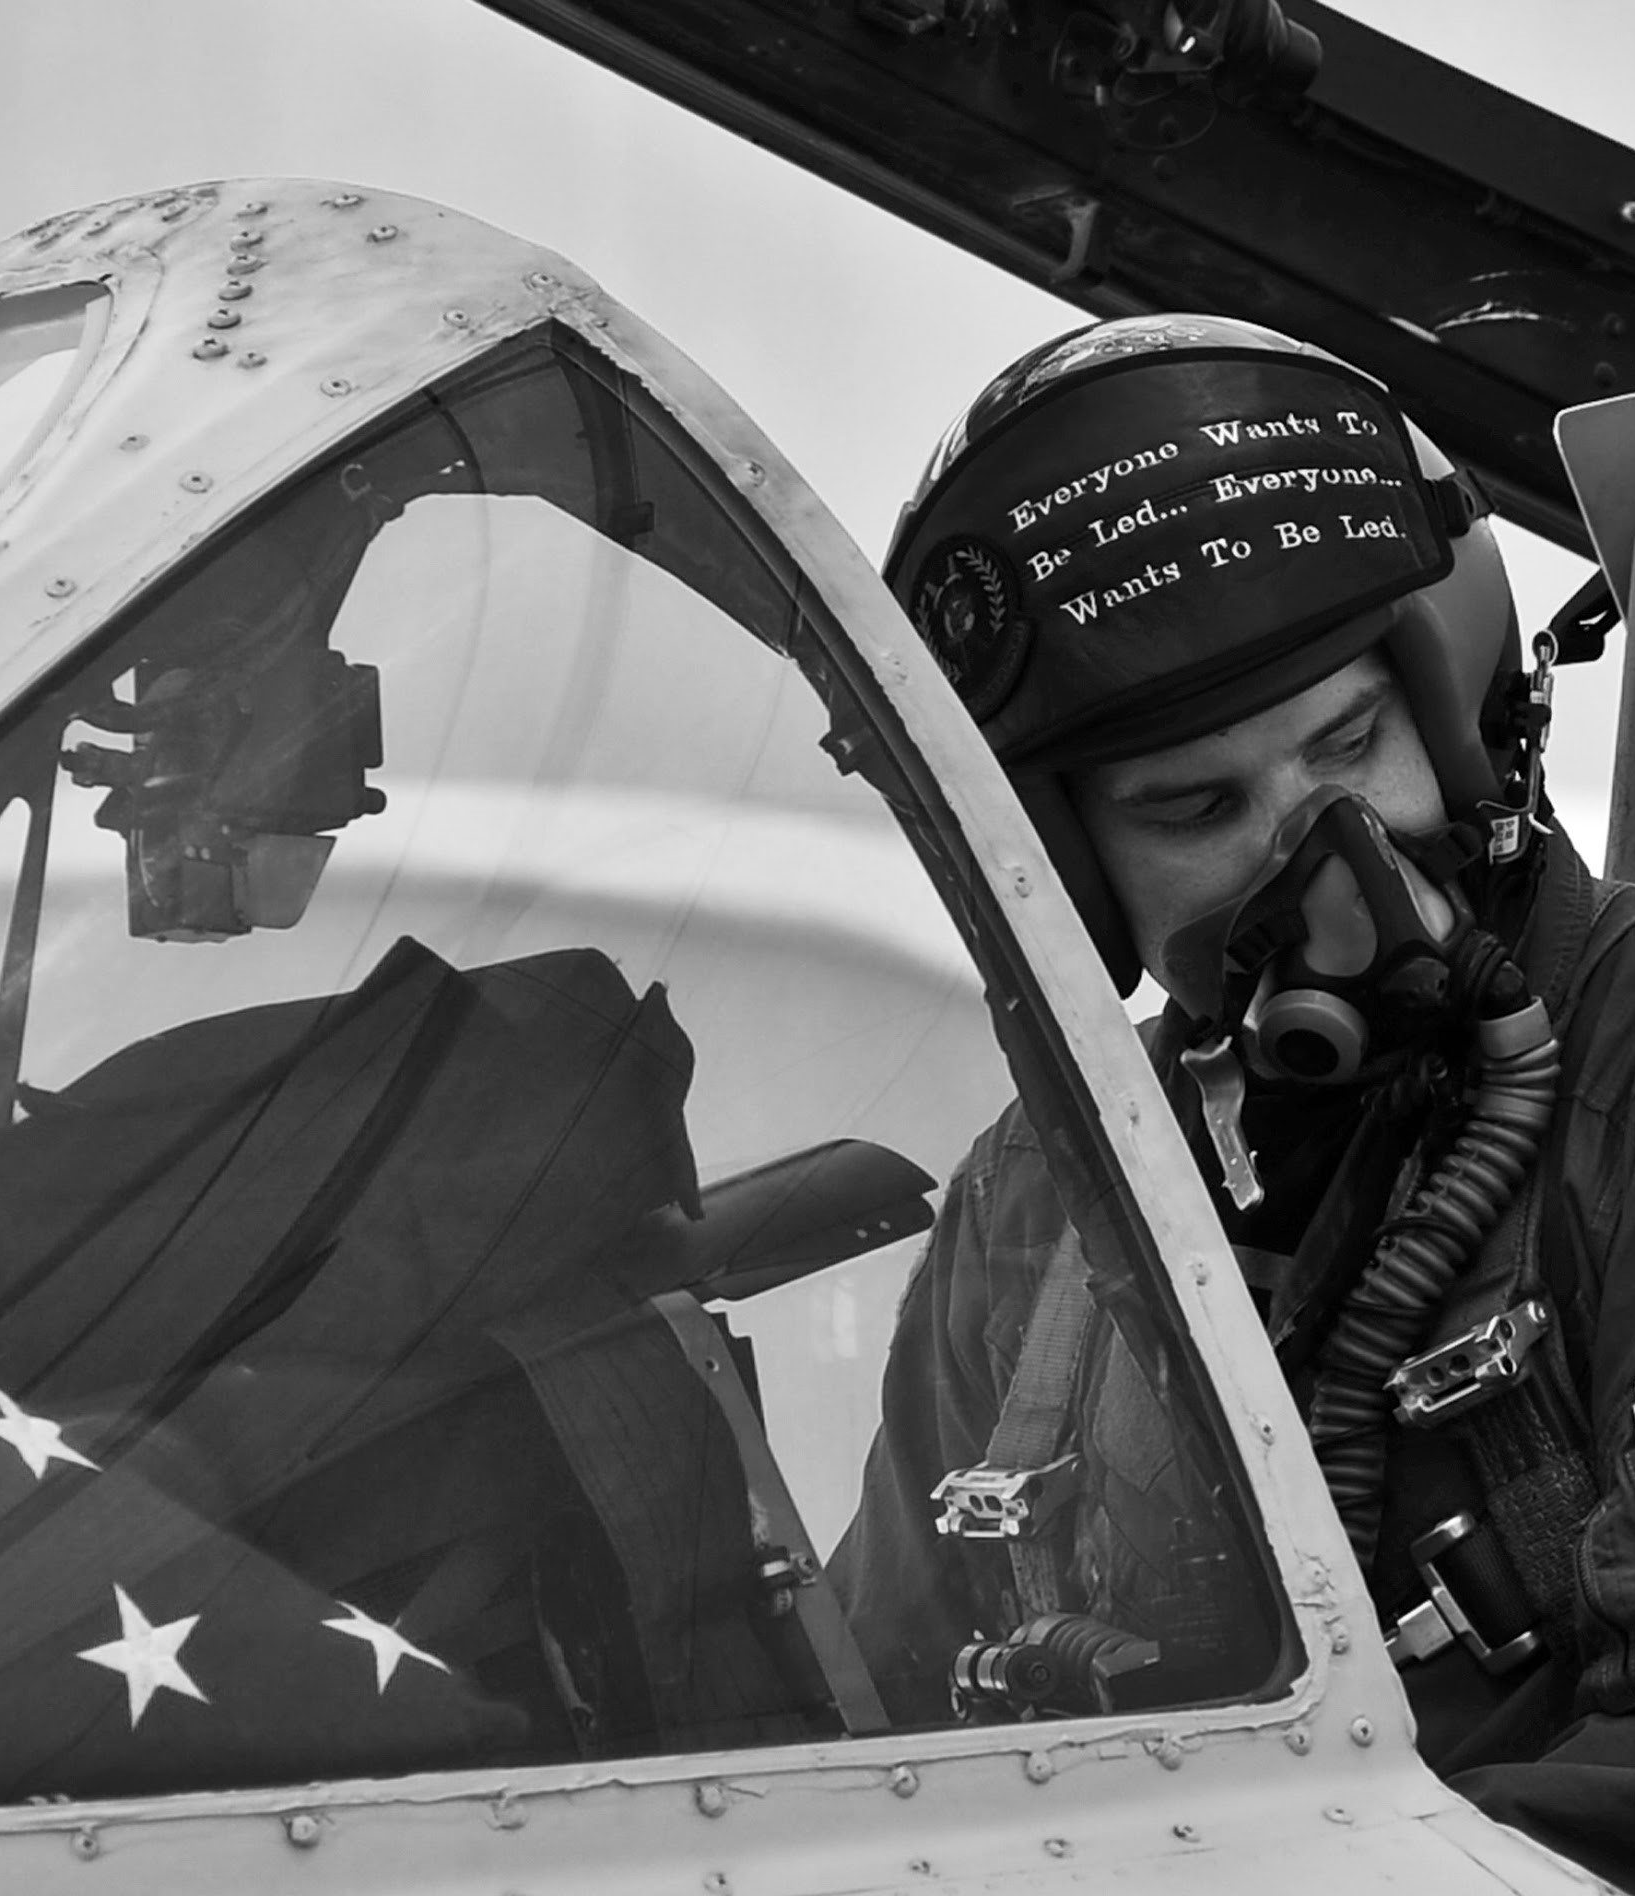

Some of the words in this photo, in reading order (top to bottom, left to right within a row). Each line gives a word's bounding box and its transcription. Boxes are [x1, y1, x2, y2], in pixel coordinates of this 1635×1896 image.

[1007, 441, 1180, 533] Everyone
[1198, 411, 1321, 448] Wants
[1336, 410, 1379, 437] To
[1026, 547, 1072, 583] Be
[1087, 497, 1189, 549] Led...
[1212, 466, 1403, 504] Everyone...
[1060, 557, 1182, 626] Wants
[1200, 536, 1253, 569] To
[1273, 520, 1322, 549] Be
[1340, 513, 1407, 541] Led.
